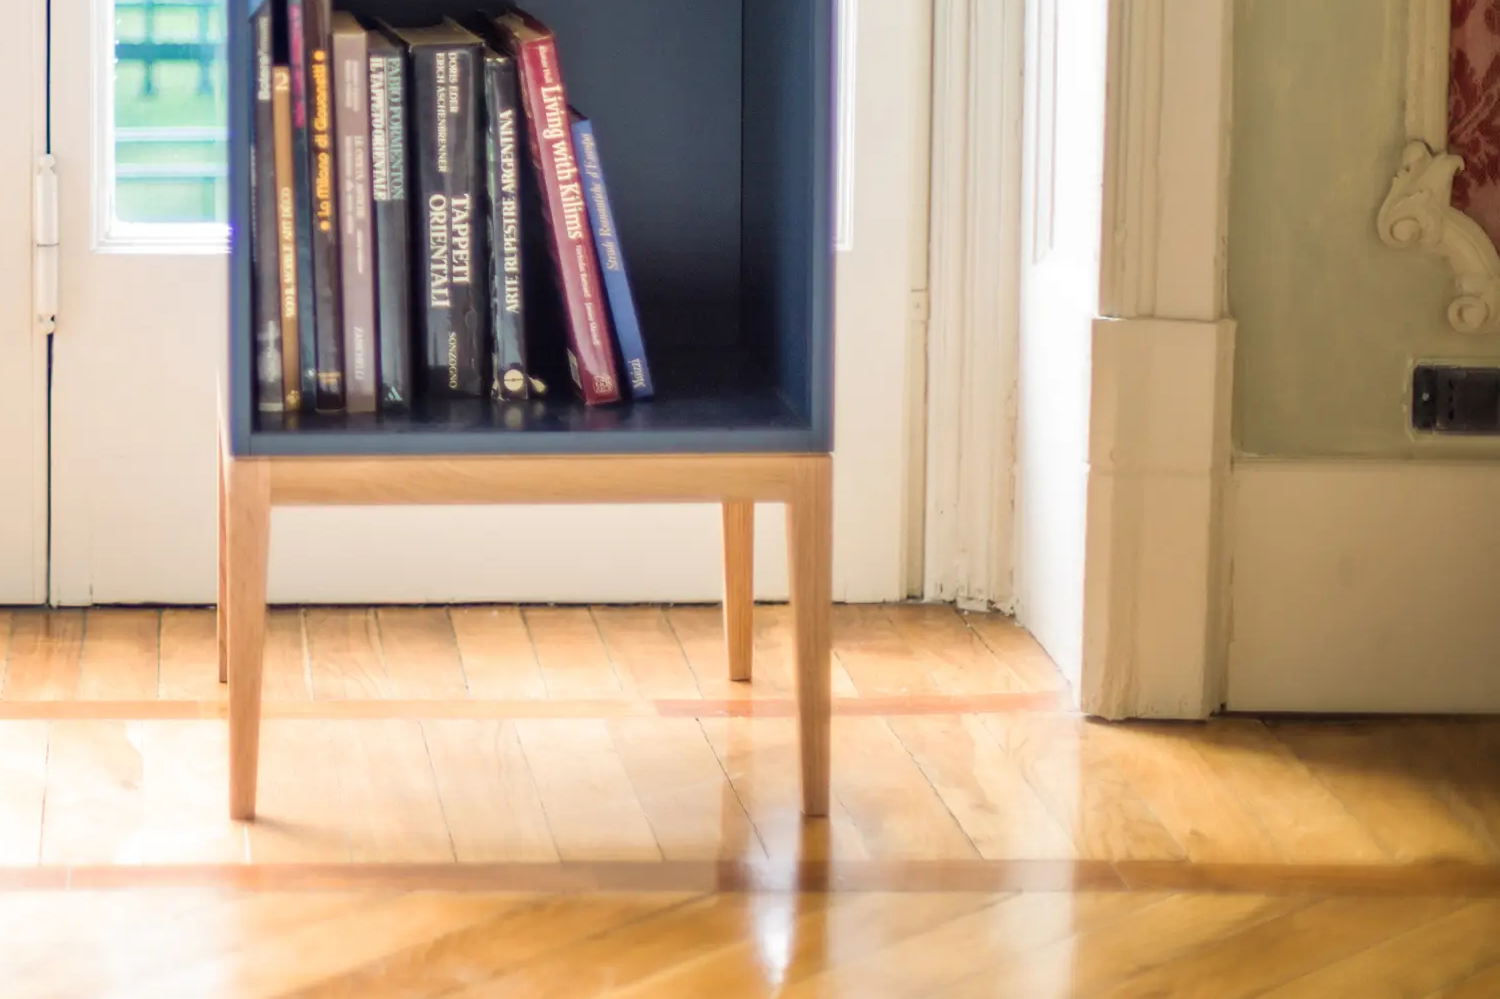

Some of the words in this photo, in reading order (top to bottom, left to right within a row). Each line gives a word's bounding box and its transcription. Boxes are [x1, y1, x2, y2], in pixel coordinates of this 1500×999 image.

[274, 71, 289, 91] 2
[386, 57, 402, 102] FABIO
[435, 52, 446, 84] ERICH
[447, 52, 458, 84] DORIS
[436, 85, 448, 173] ASCHENBRENNER
[541, 84, 565, 140] Living
[314, 134, 329, 149] di
[388, 105, 405, 200] FORMENTON
[498, 108, 518, 193] ARGENTINA
[551, 141, 578, 181] with
[315, 151, 330, 199] Milano
[451, 193, 470, 284] TAPPETI
[501, 195, 519, 274] RUPESTRE
[559, 182, 585, 240] Kilims
[429, 193, 451, 308] ORIENTALI
[504, 274, 520, 315] ARTE
[449, 331, 458, 389] SONZOGNO
